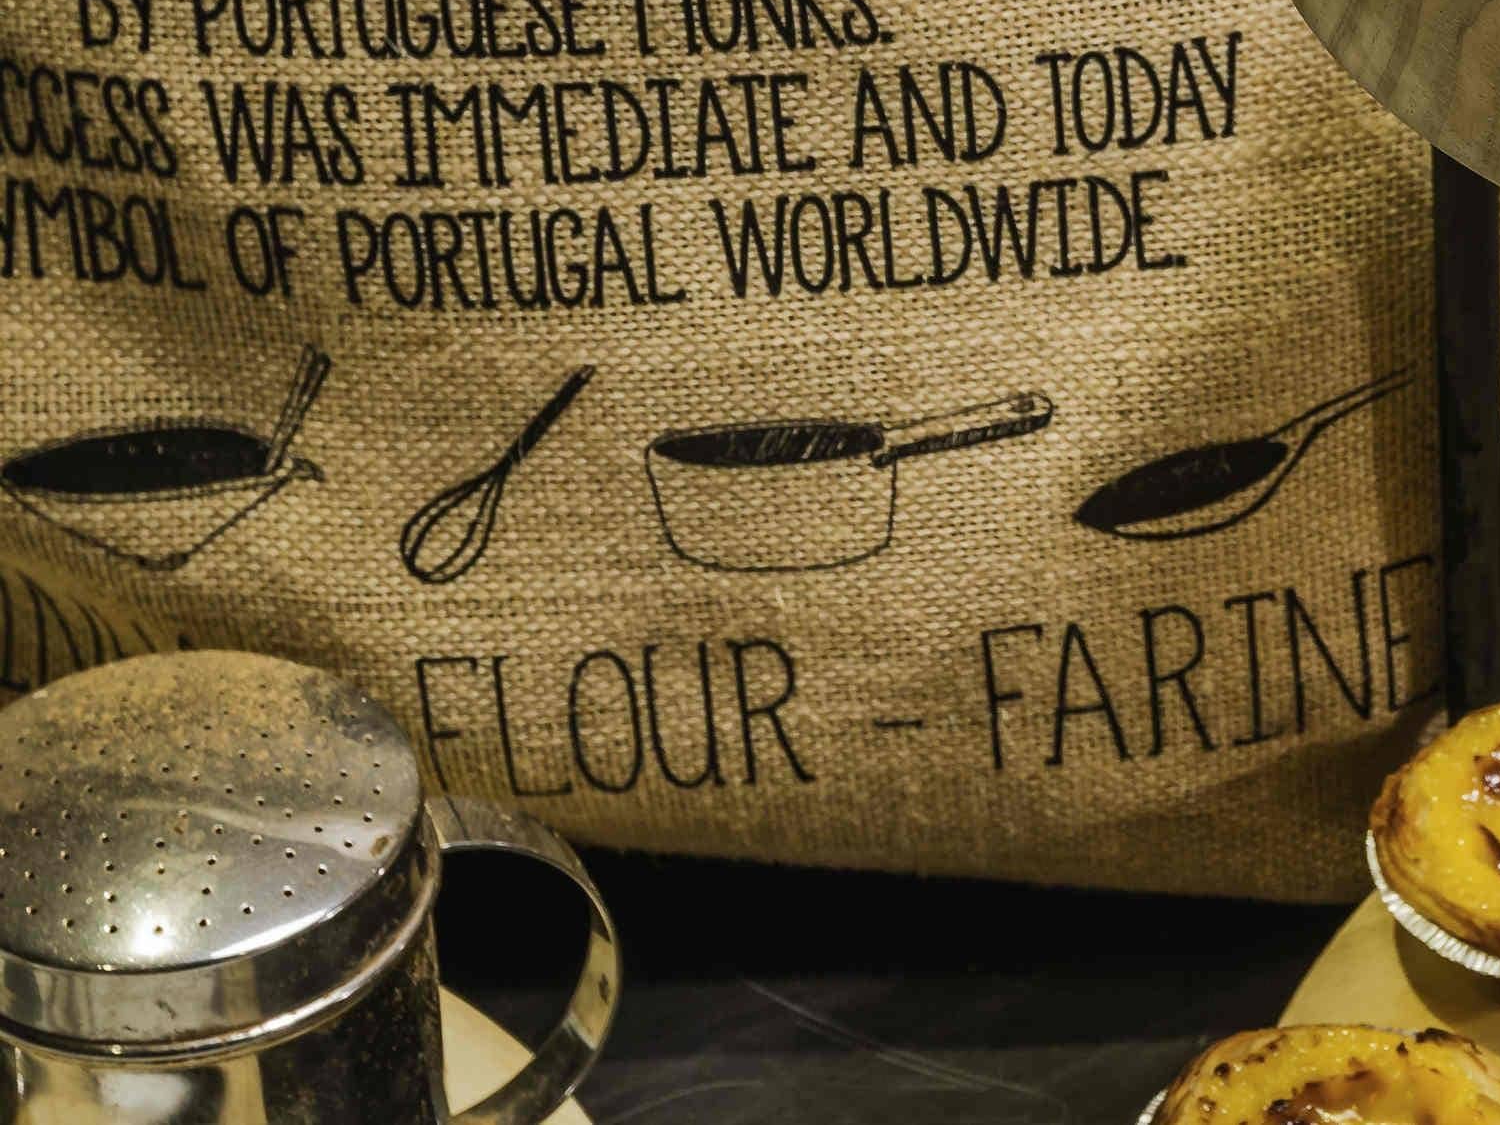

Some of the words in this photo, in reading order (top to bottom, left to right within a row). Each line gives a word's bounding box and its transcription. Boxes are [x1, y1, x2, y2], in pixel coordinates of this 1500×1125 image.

[201, 79, 364, 187] WAS
[389, 73, 815, 187] IMMEDIATE
[849, 61, 1007, 169] AND
[1036, 31, 1241, 155] TODAY
[227, 206, 302, 298] OF
[336, 203, 687, 309] PORTUGAL
[711, 171, 1187, 299] WORLDWIDE.
[417, 637, 816, 797] FLOUR
[980, 555, 1440, 771] FARINE
